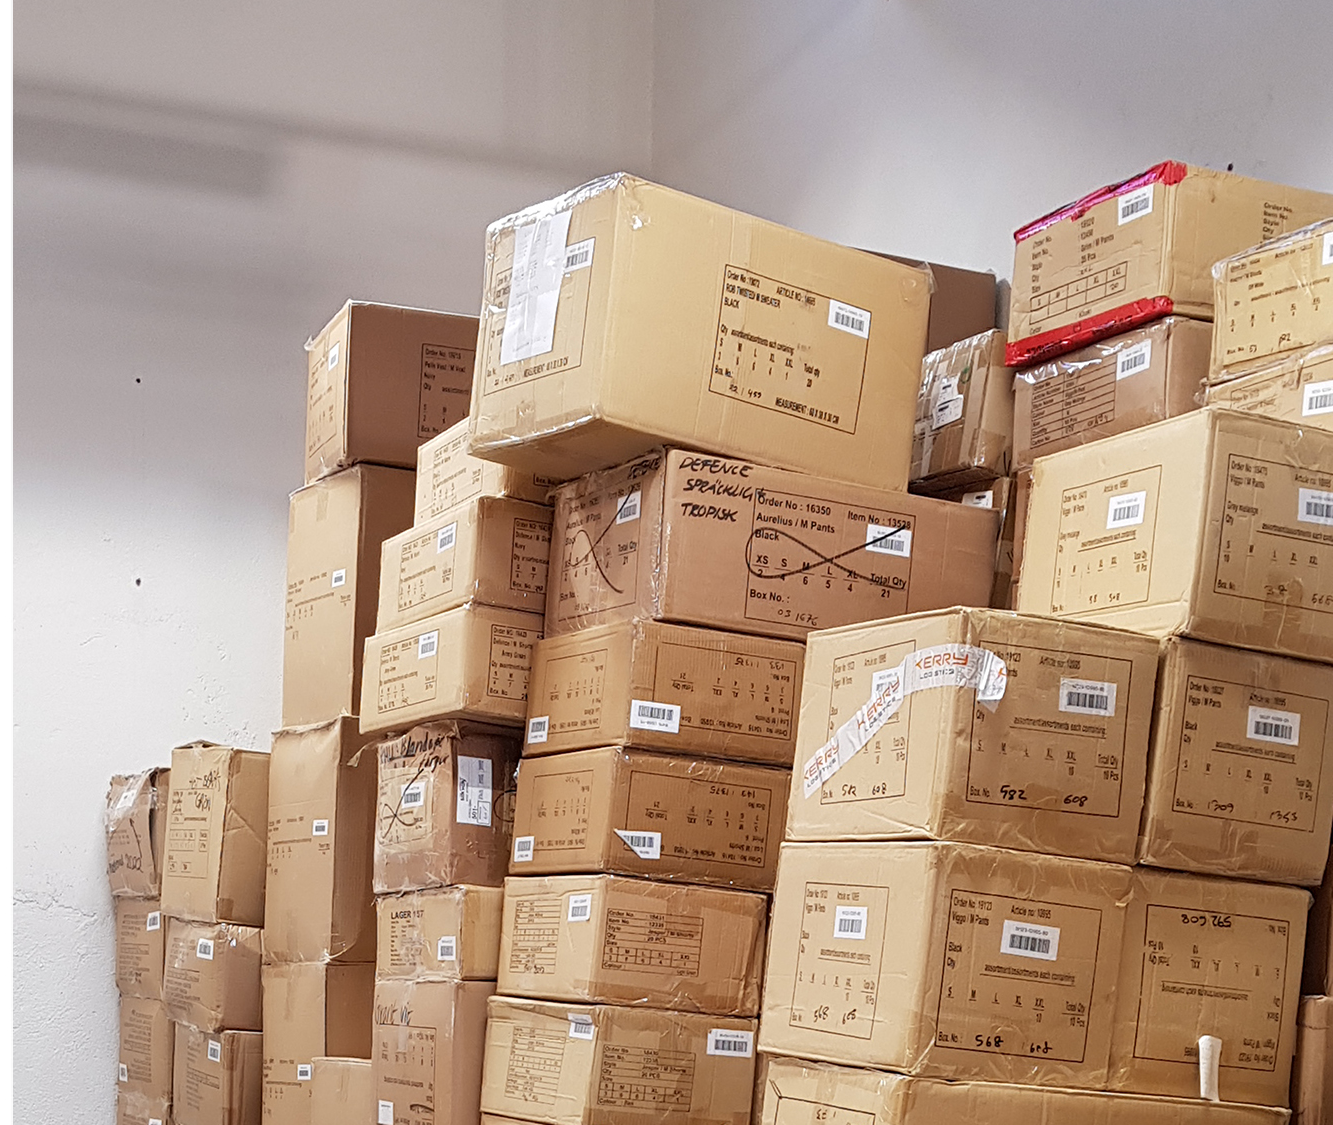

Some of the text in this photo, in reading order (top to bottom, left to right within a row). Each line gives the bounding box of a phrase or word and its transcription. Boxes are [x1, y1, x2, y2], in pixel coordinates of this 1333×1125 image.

[724, 296, 739, 309] BLACK
[760, 295, 781, 309] SWEATER
[679, 457, 754, 477] DEFENCE
[683, 478, 753, 502] SPRÄCKLIG
[681, 503, 738, 522] TROPISK
[758, 495, 831, 516] Order No 16350
[756, 512, 835, 534] Aurelius M Pants
[848, 511, 866, 522] Item
[868, 514, 879, 524] No
[755, 529, 780, 541] Black
[756, 555, 769, 565] XS
[781, 558, 788, 568] S
[827, 566, 832, 576] L
[803, 576, 891, 599] 6 5 4 21
[870, 573, 907, 590] Total Qty
[750, 589, 766, 600] Box
[915, 652, 968, 669] KERRY
[857, 676, 900, 730] KERRY
[804, 745, 839, 780] KERRY
[953, 896, 967, 908] Order
[391, 910, 424, 919] LAGER 157
[952, 910, 990, 926] Viggo Pants
[1011, 905, 1027, 917] Article
[1212, 913, 1232, 928] 592
[948, 941, 962, 953] Black
[947, 957, 955, 969] Qty
[1035, 997, 1045, 1009] XXL
[1066, 1001, 1077, 1013] Total
[1076, 1018, 1085, 1028] Pcs
[974, 1034, 1004, 1048] 568
